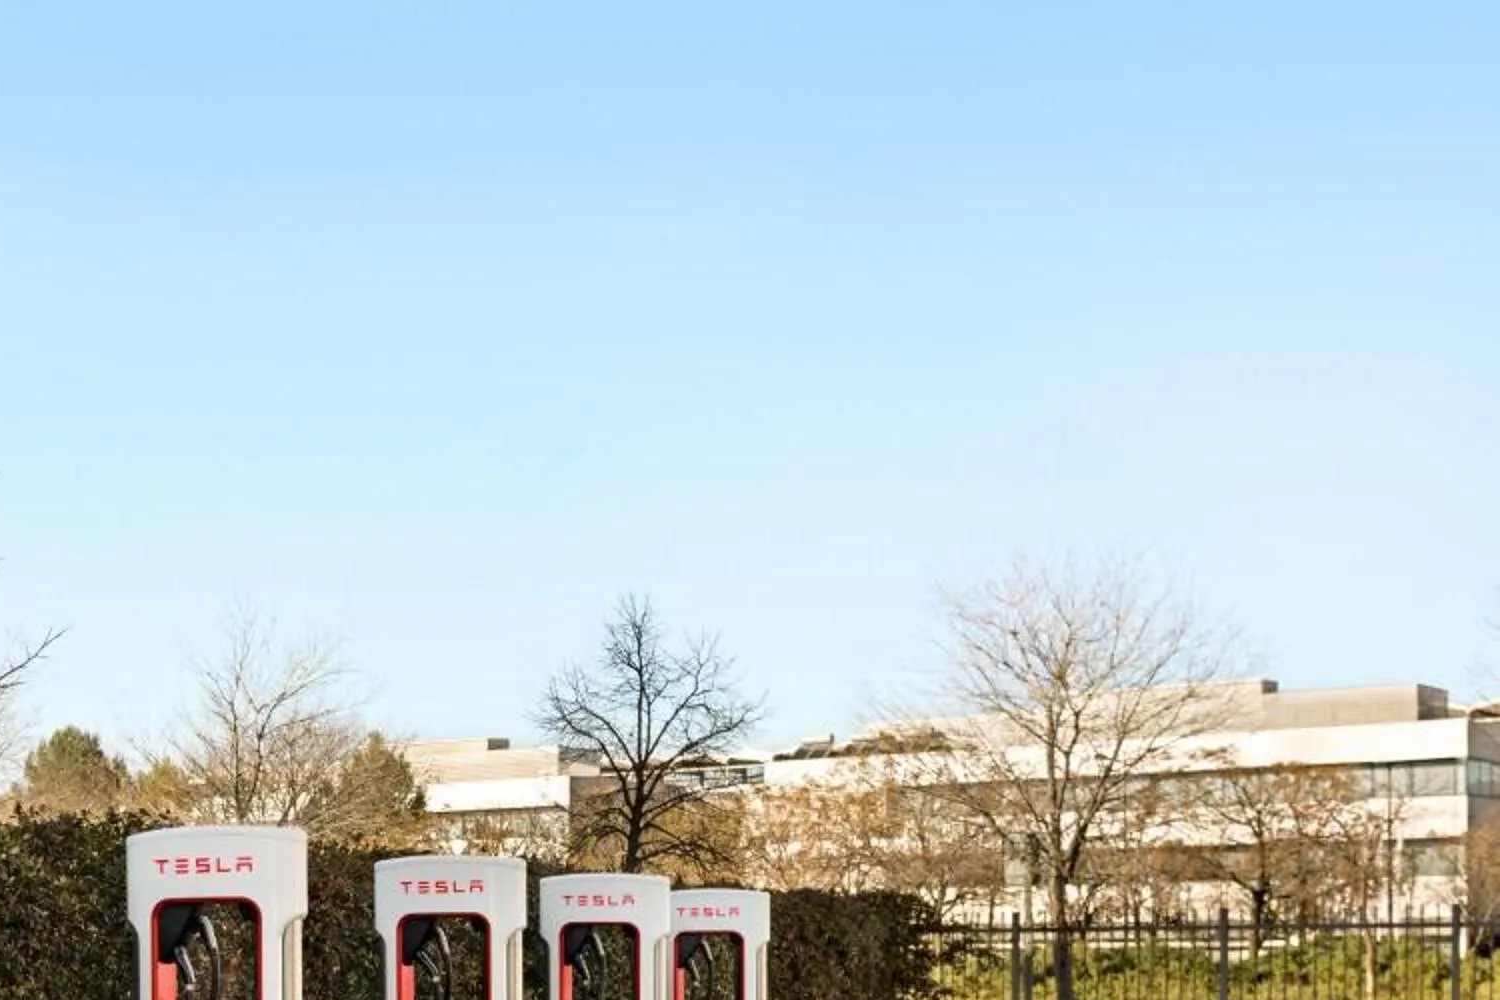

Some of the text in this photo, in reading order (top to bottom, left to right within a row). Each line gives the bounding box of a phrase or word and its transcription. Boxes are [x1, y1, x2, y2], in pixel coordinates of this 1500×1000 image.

[155, 857, 253, 875] TESLA
[401, 880, 485, 894] TESLA
[563, 895, 635, 907] TESLA
[676, 907, 740, 918] TESLA
